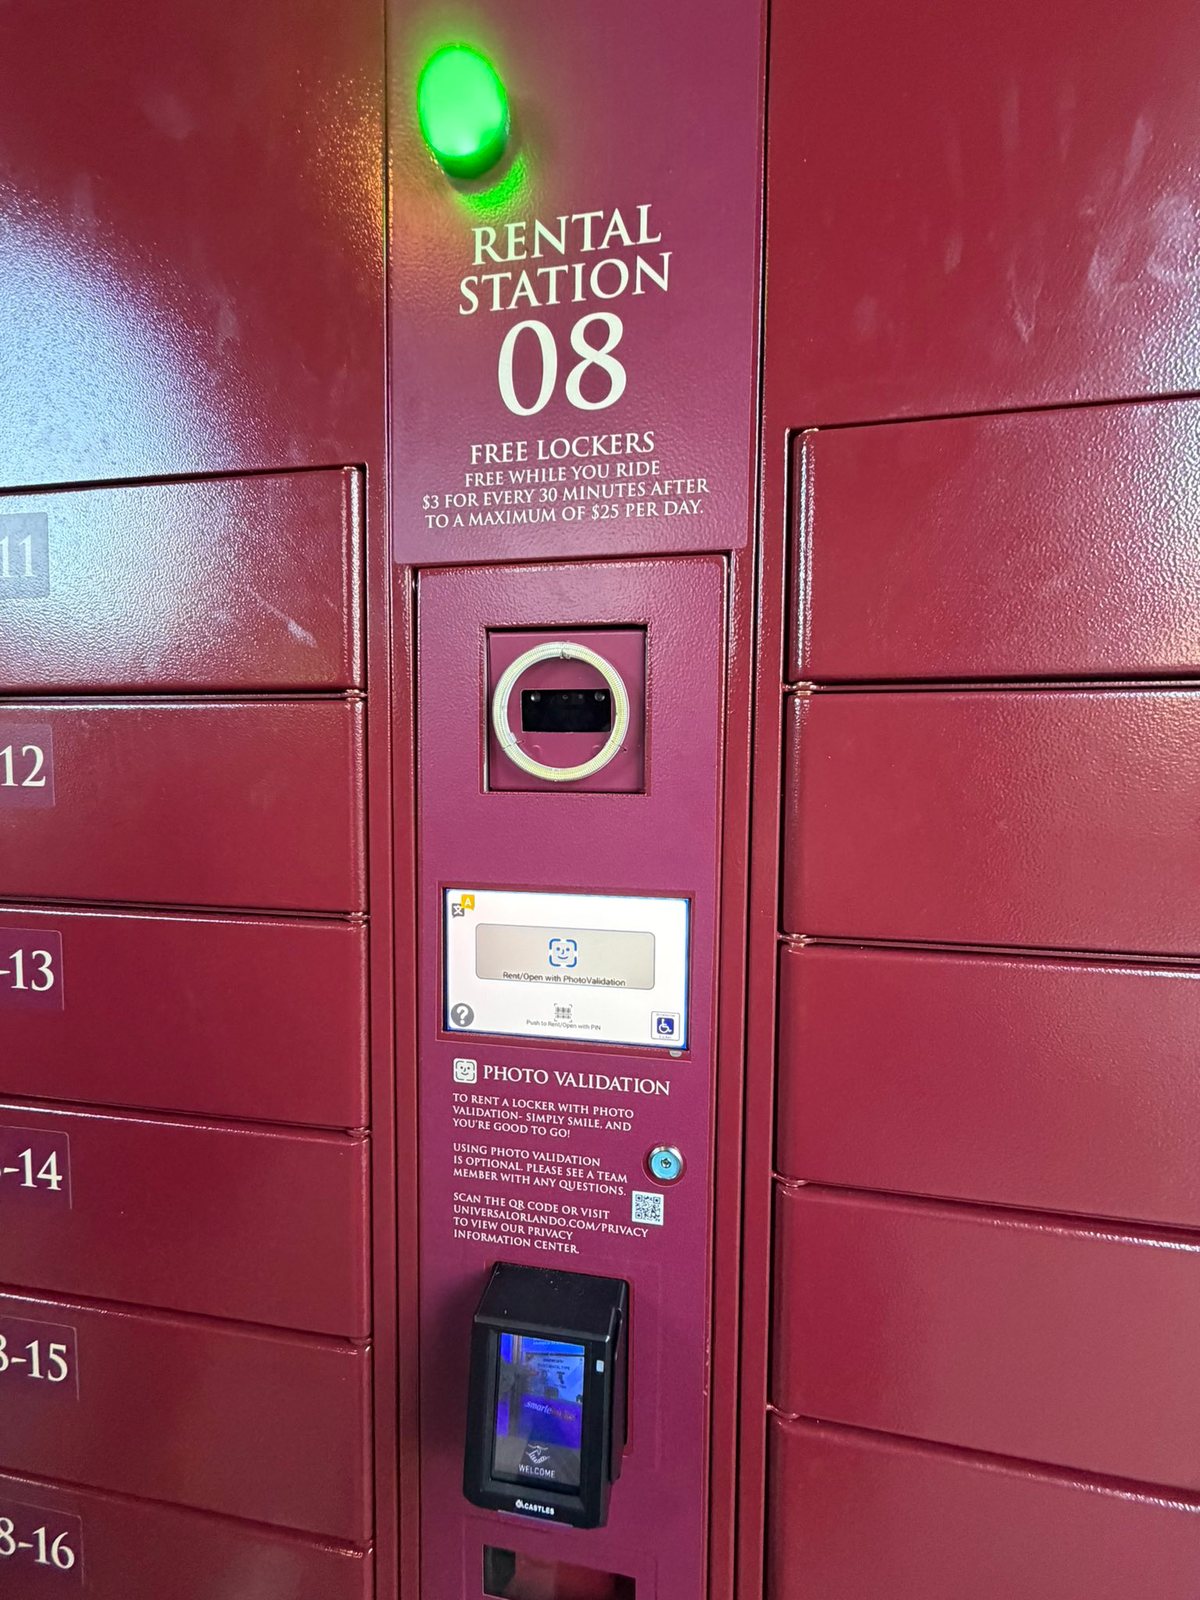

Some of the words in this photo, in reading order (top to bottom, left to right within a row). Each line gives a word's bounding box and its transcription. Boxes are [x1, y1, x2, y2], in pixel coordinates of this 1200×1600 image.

[471, 203, 662, 266] RENTAL
[458, 251, 673, 315] STATION
[498, 311, 627, 416] 08
[469, 440, 528, 465] FREE
[536, 430, 656, 462] LOCKERS
[465, 471, 504, 487] FREE
[508, 466, 567, 485] WHILE
[571, 464, 609, 481] YOU
[616, 460, 661, 477] RIDE
[422, 494, 439, 510] $3
[445, 492, 479, 508] FOR
[483, 489, 535, 506] EVERY
[538, 487, 558, 503] 30
[562, 481, 646, 501] MINUTES
[650, 478, 710, 496] AFTER
[425, 514, 449, 528] TO
[452, 513, 464, 527] A
[468, 506, 557, 525] MAXIMUM
[562, 505, 585, 521] OF
[591, 503, 619, 521] $25
[625, 502, 659, 518] PER
[663, 499, 704, 516] DAY.
[0, 744, 46, 787] 12
[502, 971, 544, 982] Rent/Open
[545, 974, 561, 982] with
[563, 975, 626, 987] PhotoValidation
[483, 1064, 549, 1085] PHOTO
[553, 1071, 671, 1096] VALIDATION
[452, 1105, 523, 1120] VALIDATION-
[526, 1112, 565, 1126] SIMPLY
[605, 1120, 632, 1132] AND
[453, 1093, 468, 1103] TO
[471, 1094, 500, 1106] RENT
[501, 1098, 510, 1107] A
[512, 1098, 556, 1112] LOCKER
[557, 1102, 589, 1115] WITH
[593, 1106, 634, 1119] PHOTO
[452, 1118, 491, 1130] YOU'RE
[493, 1122, 528, 1134] GOOD
[531, 1125, 547, 1136] TO
[549, 1128, 571, 1138] GO!
[453, 1142, 488, 1155] USING
[490, 1146, 530, 1159] PHOTO
[532, 1150, 601, 1167] VALIDATION
[0, 1147, 63, 1191] -14
[453, 1155, 463, 1165] IS
[465, 1157, 524, 1172] OPTIONAL.
[526, 1163, 563, 1176] PLEASE
[566, 1168, 584, 1179] SEE
[586, 1170, 596, 1180] A
[597, 1171, 628, 1184] TEAM
[453, 1168, 499, 1181] MEMBER
[500, 1172, 531, 1185] WITH
[533, 1177, 556, 1188] ANY
[558, 1180, 627, 1196] QUESTIONS.
[453, 1192, 482, 1204] SCAN
[484, 1196, 506, 1207] THE
[508, 1198, 526, 1211] QR
[527, 1200, 559, 1214] CODE
[561, 1205, 579, 1216] OR
[580, 1207, 610, 1220] VISIT
[453, 1205, 649, 1238] UNIVERSALORLANDO.COM/PRIVACY
[453, 1216, 469, 1227] TO
[470, 1218, 499, 1231] VIEW
[501, 1222, 525, 1235] OUR
[527, 1226, 573, 1241] PRIVACY
[453, 1229, 531, 1247] INFORMATION
[518, 1463, 556, 1479] WELCOME
[524, 1502, 555, 1515] CASTLES
[0, 1517, 75, 1569] 8-16
